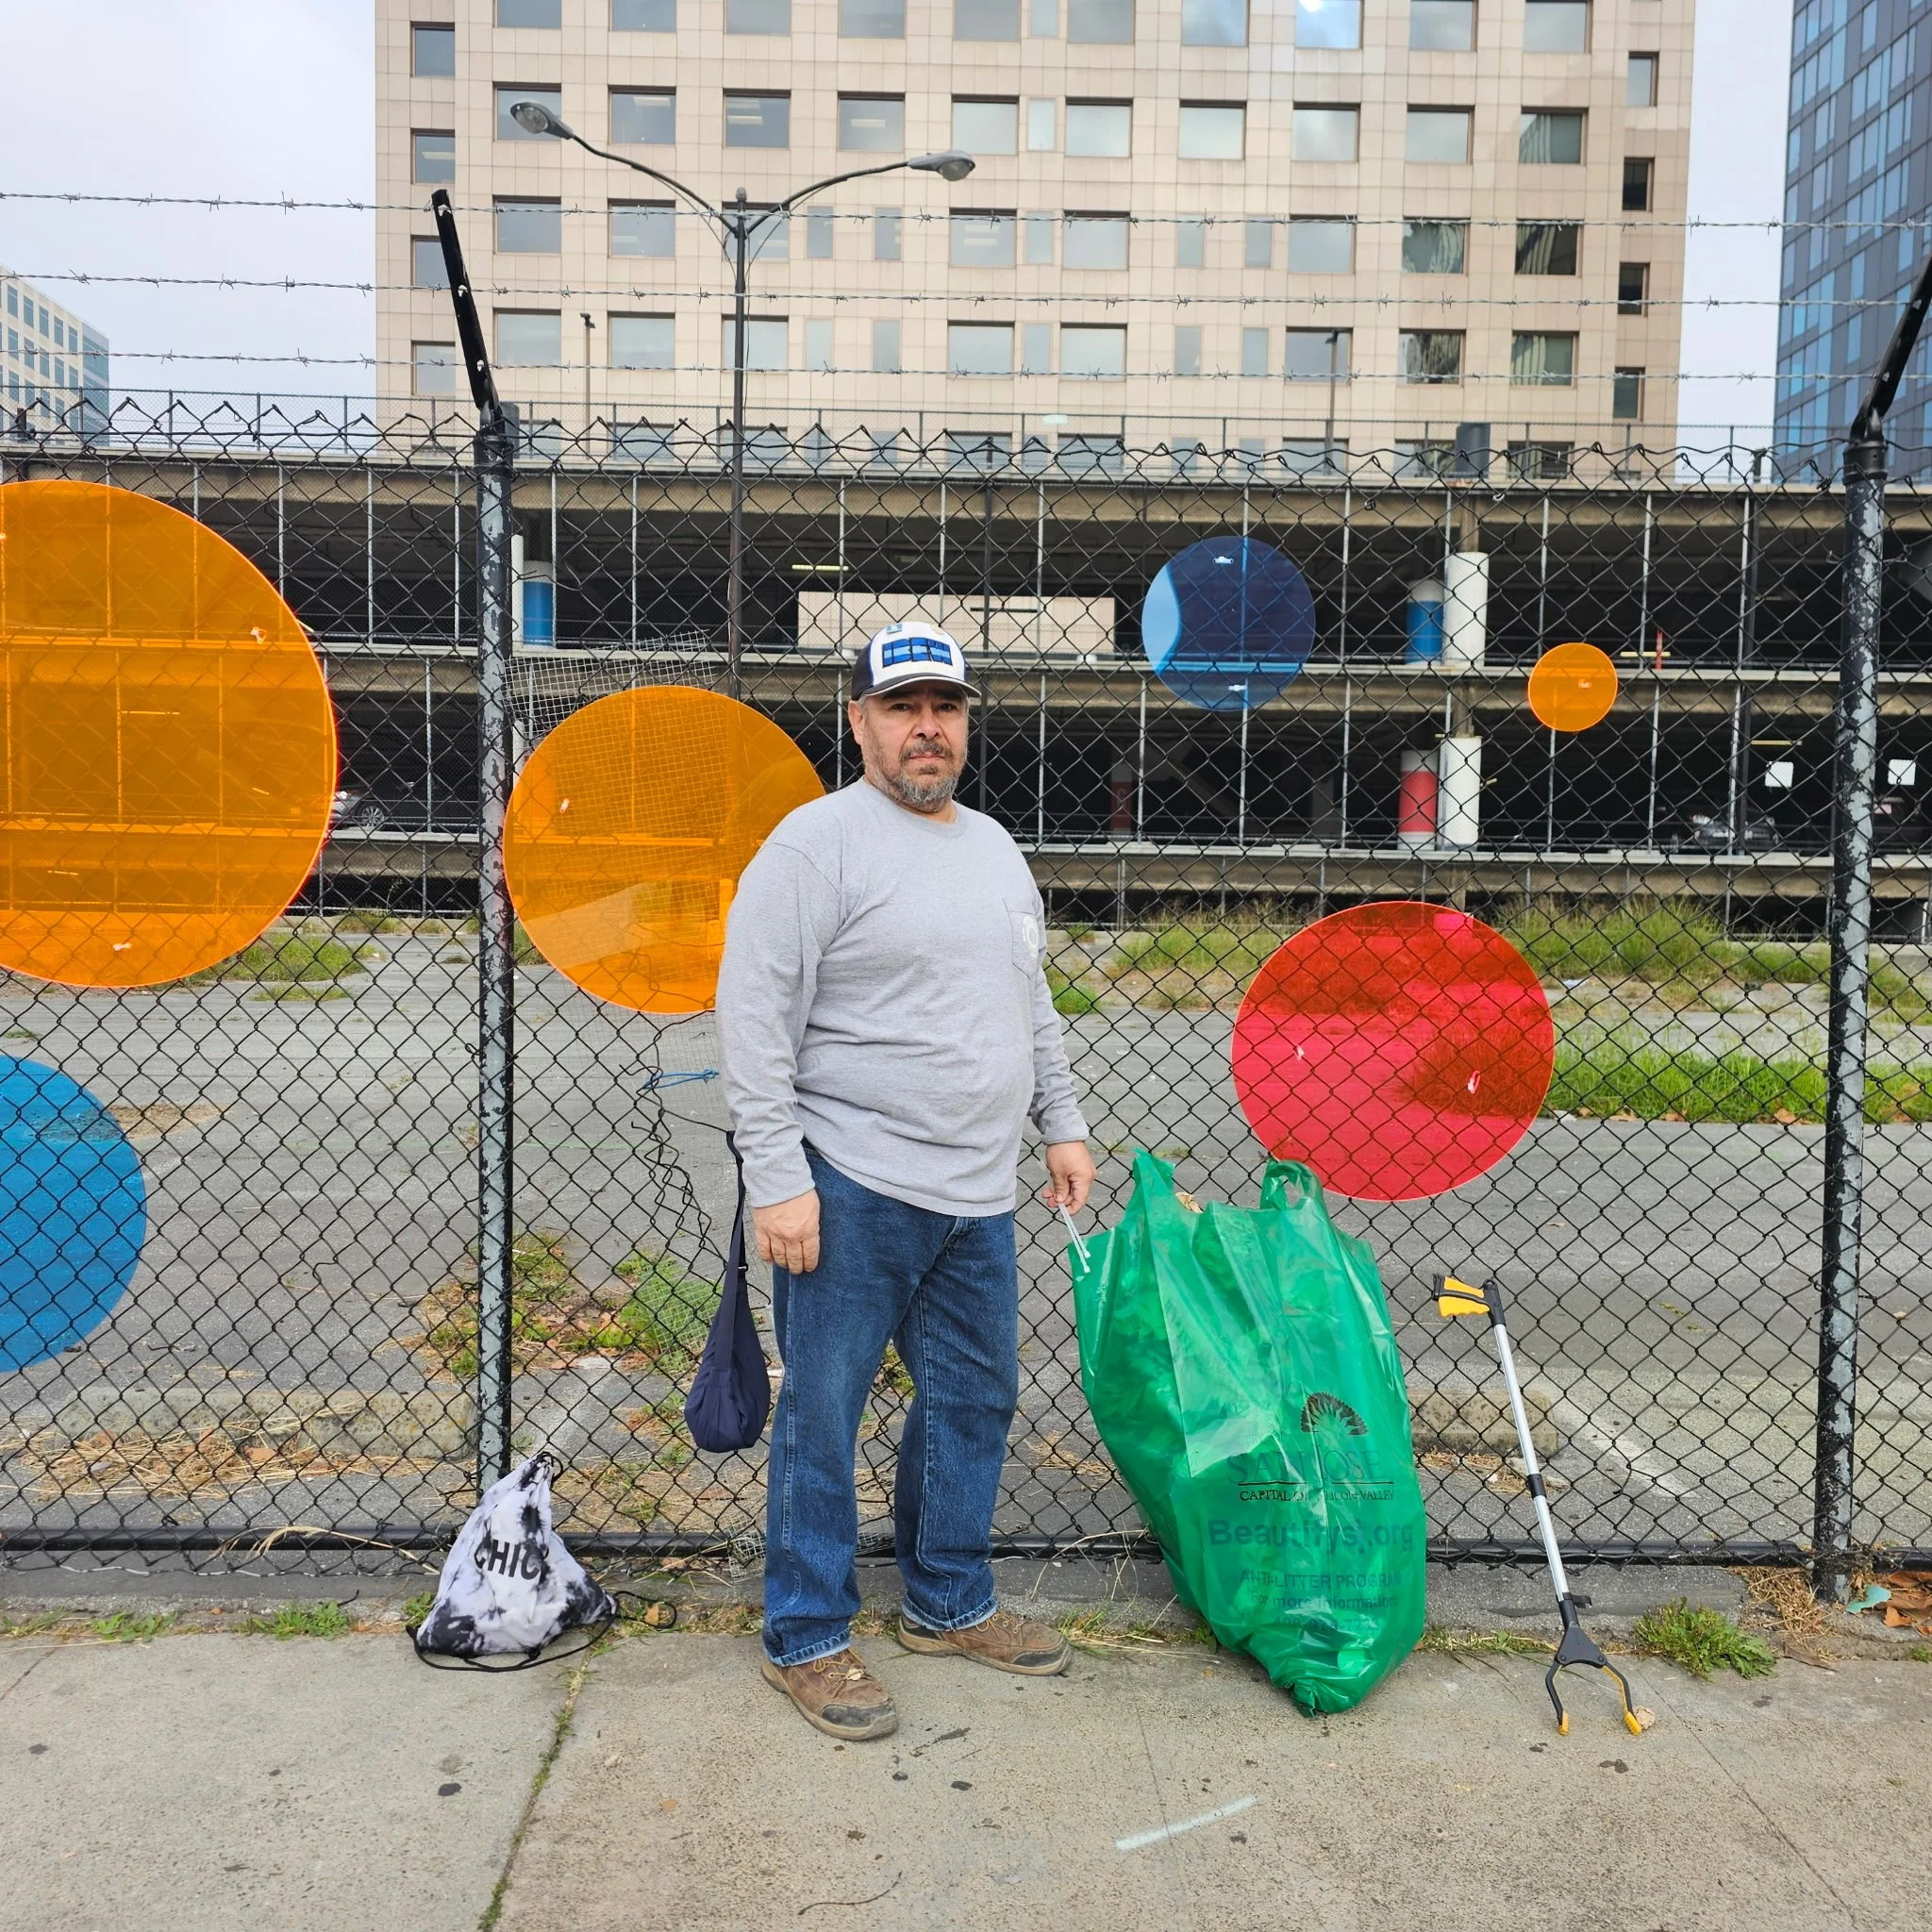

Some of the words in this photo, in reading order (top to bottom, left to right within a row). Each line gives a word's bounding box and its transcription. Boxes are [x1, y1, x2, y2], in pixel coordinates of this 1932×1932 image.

[1227, 1450, 1306, 1484] SAN
[1240, 1491, 1291, 1502] CAPITAL
[1359, 1490, 1394, 1501] VALLEY
